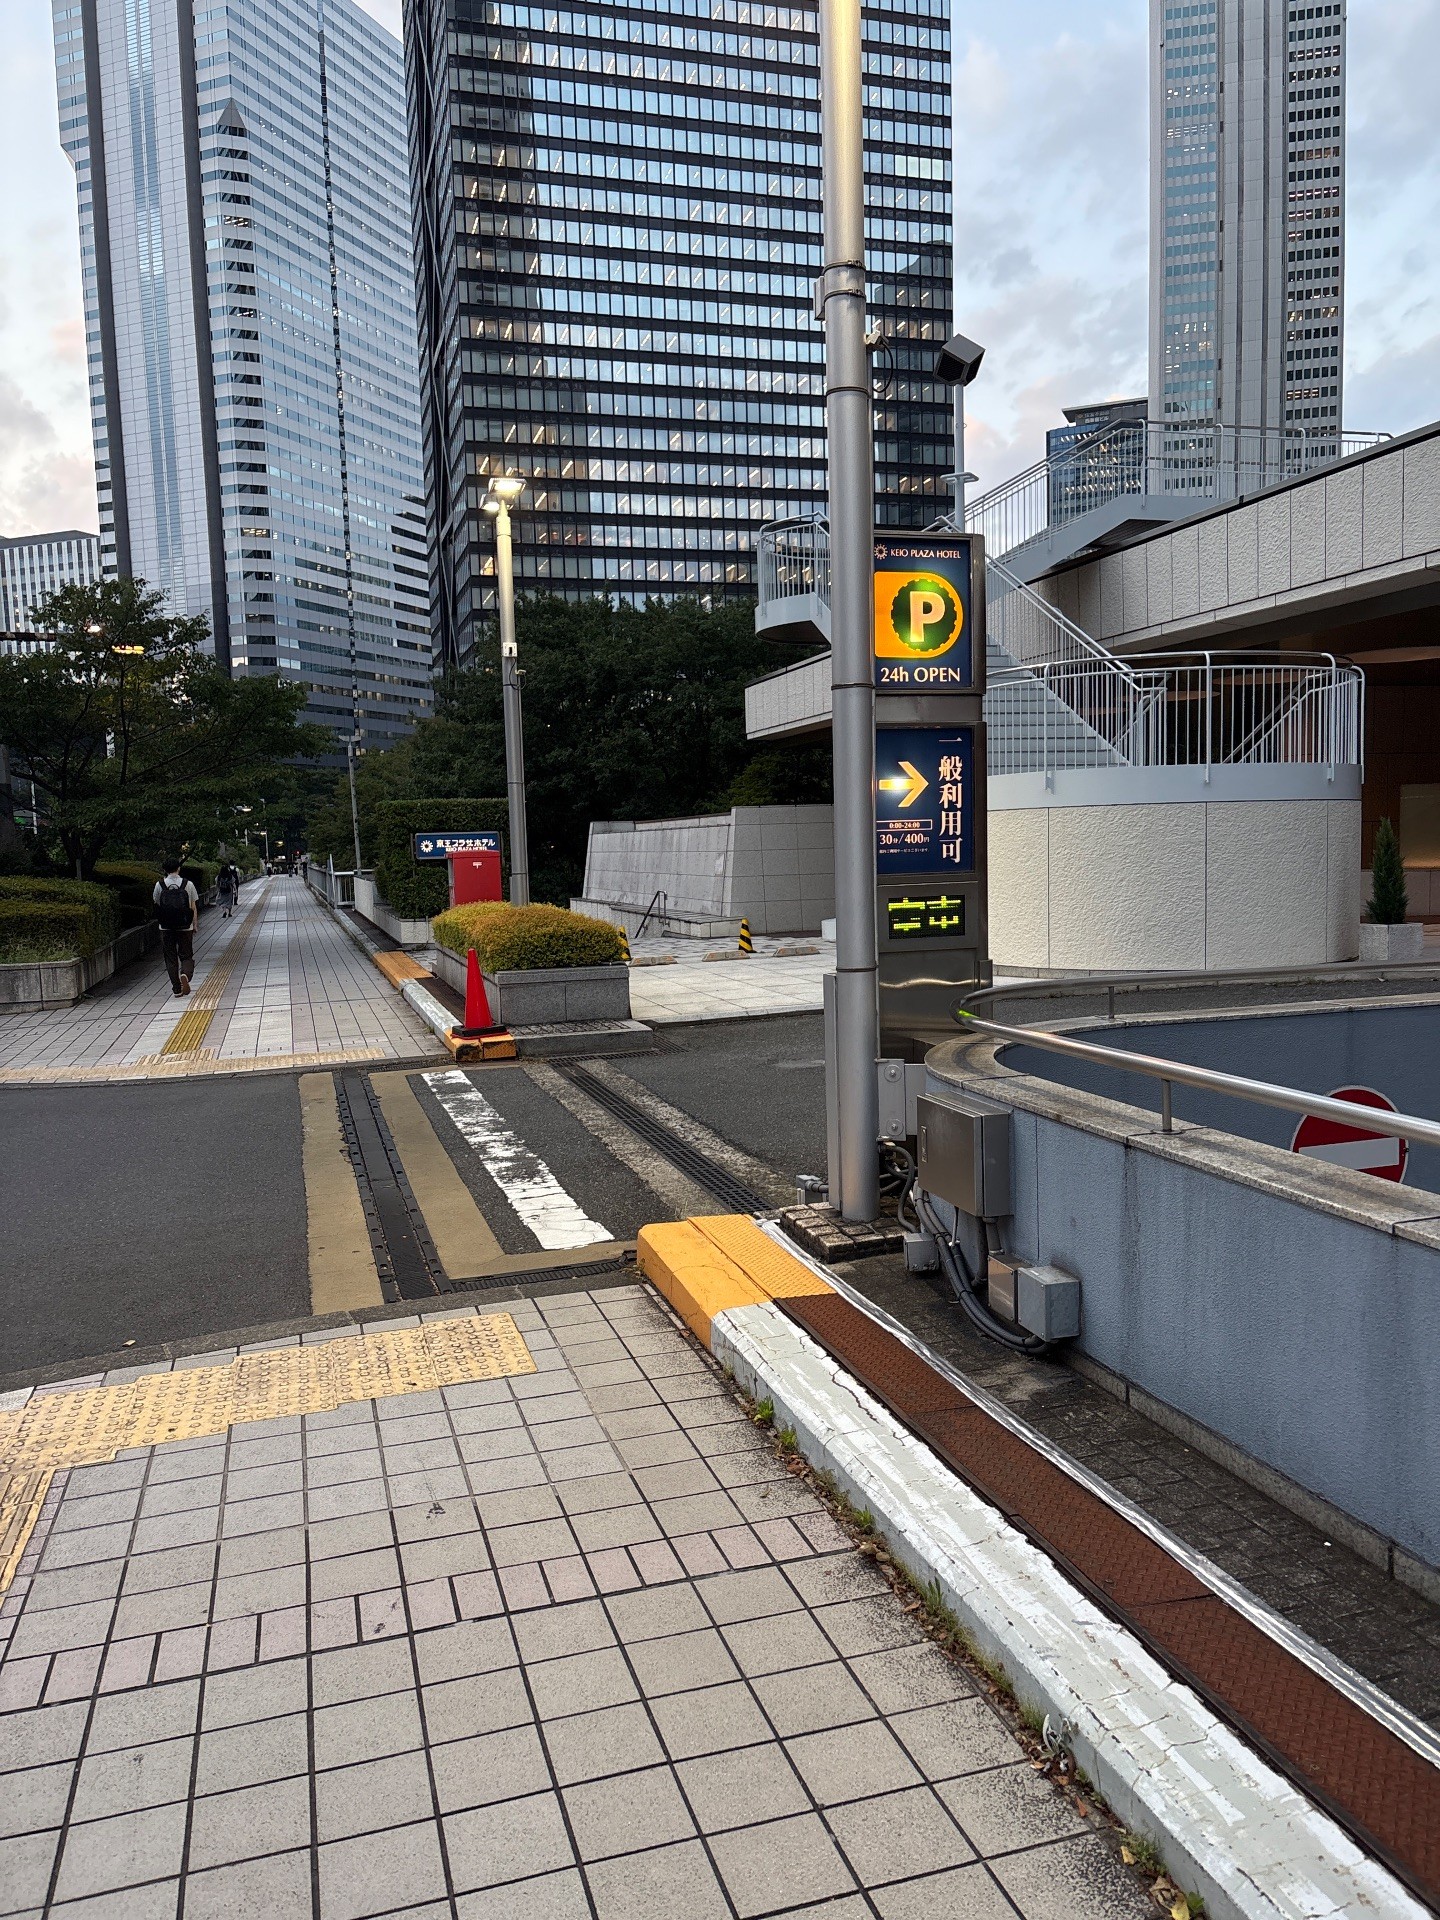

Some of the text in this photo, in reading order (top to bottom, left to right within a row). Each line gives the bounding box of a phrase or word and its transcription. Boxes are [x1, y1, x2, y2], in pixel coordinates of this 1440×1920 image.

[890, 548, 961, 559] KEIO PLAZA HOTEL
[909, 590, 946, 642] P
[880, 667, 961, 682] 24h OPEN
[938, 736, 963, 864] 一般利用可
